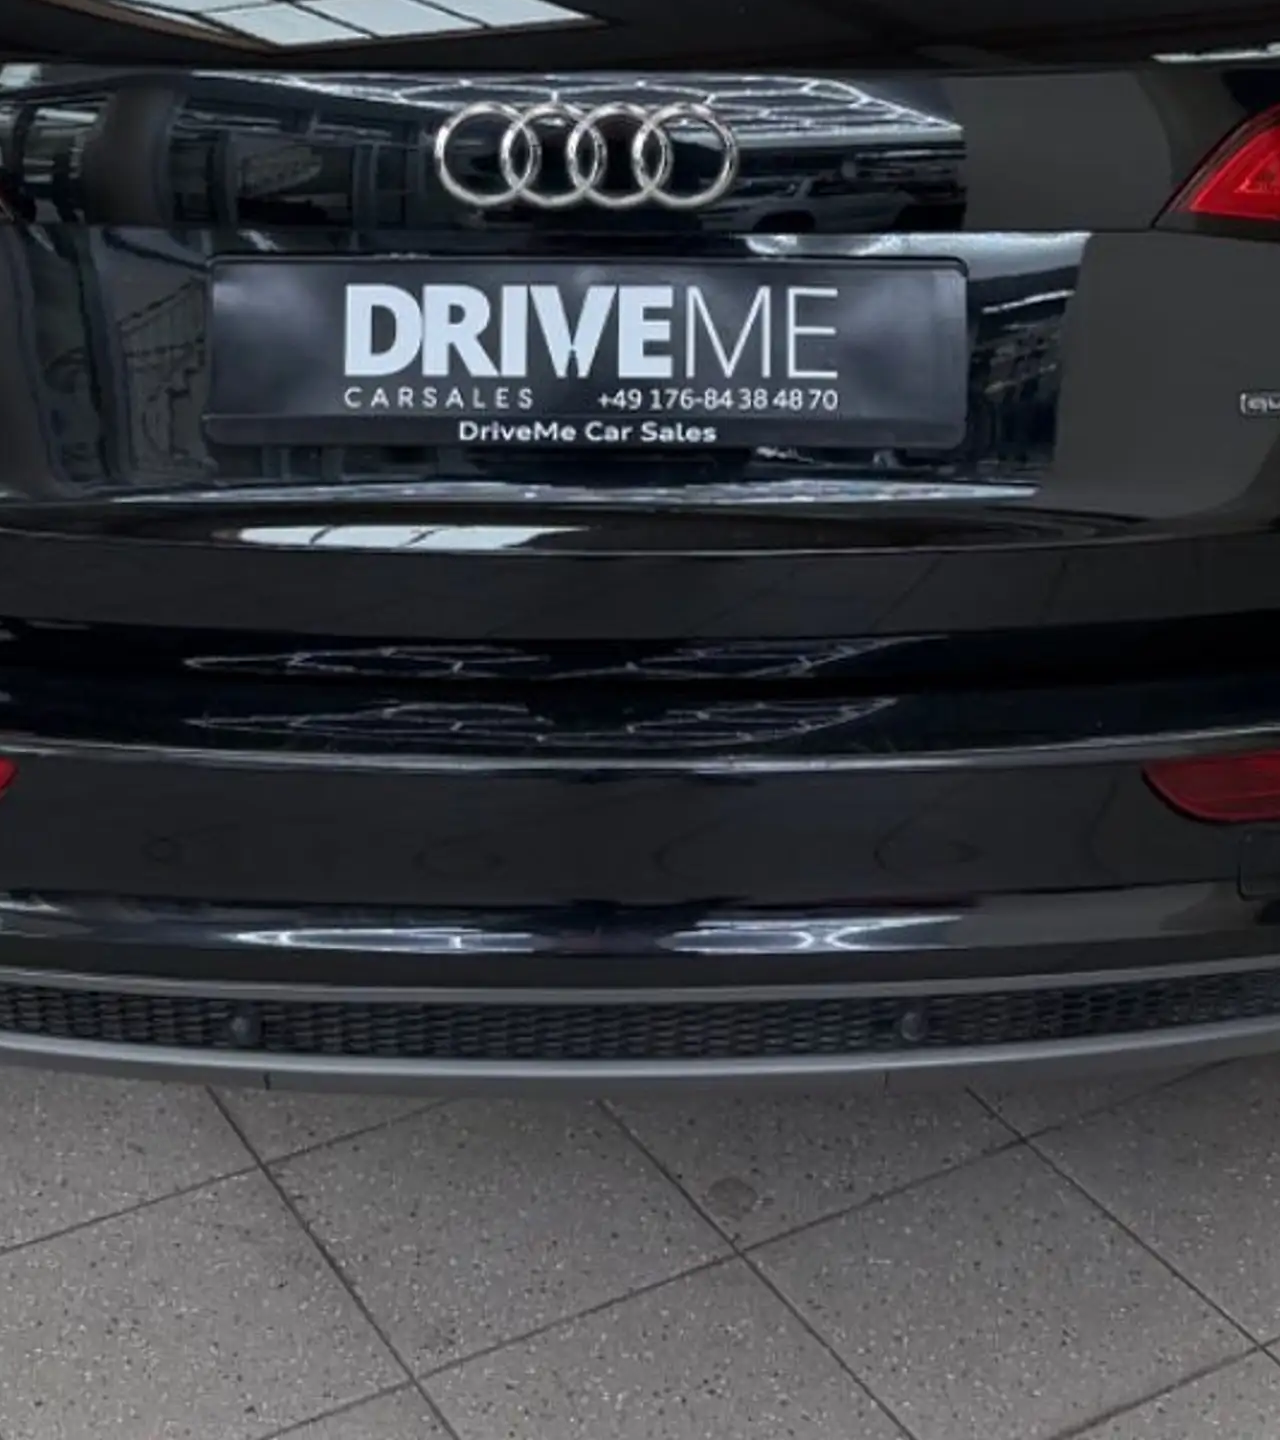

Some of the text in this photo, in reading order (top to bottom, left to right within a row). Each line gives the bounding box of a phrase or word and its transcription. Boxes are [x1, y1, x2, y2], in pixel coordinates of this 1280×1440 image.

[344, 284, 838, 379] DRIVEME
[343, 386, 534, 409] CARSALES
[598, 388, 642, 410] +49
[459, 421, 718, 443] DriveMe Car Sales
